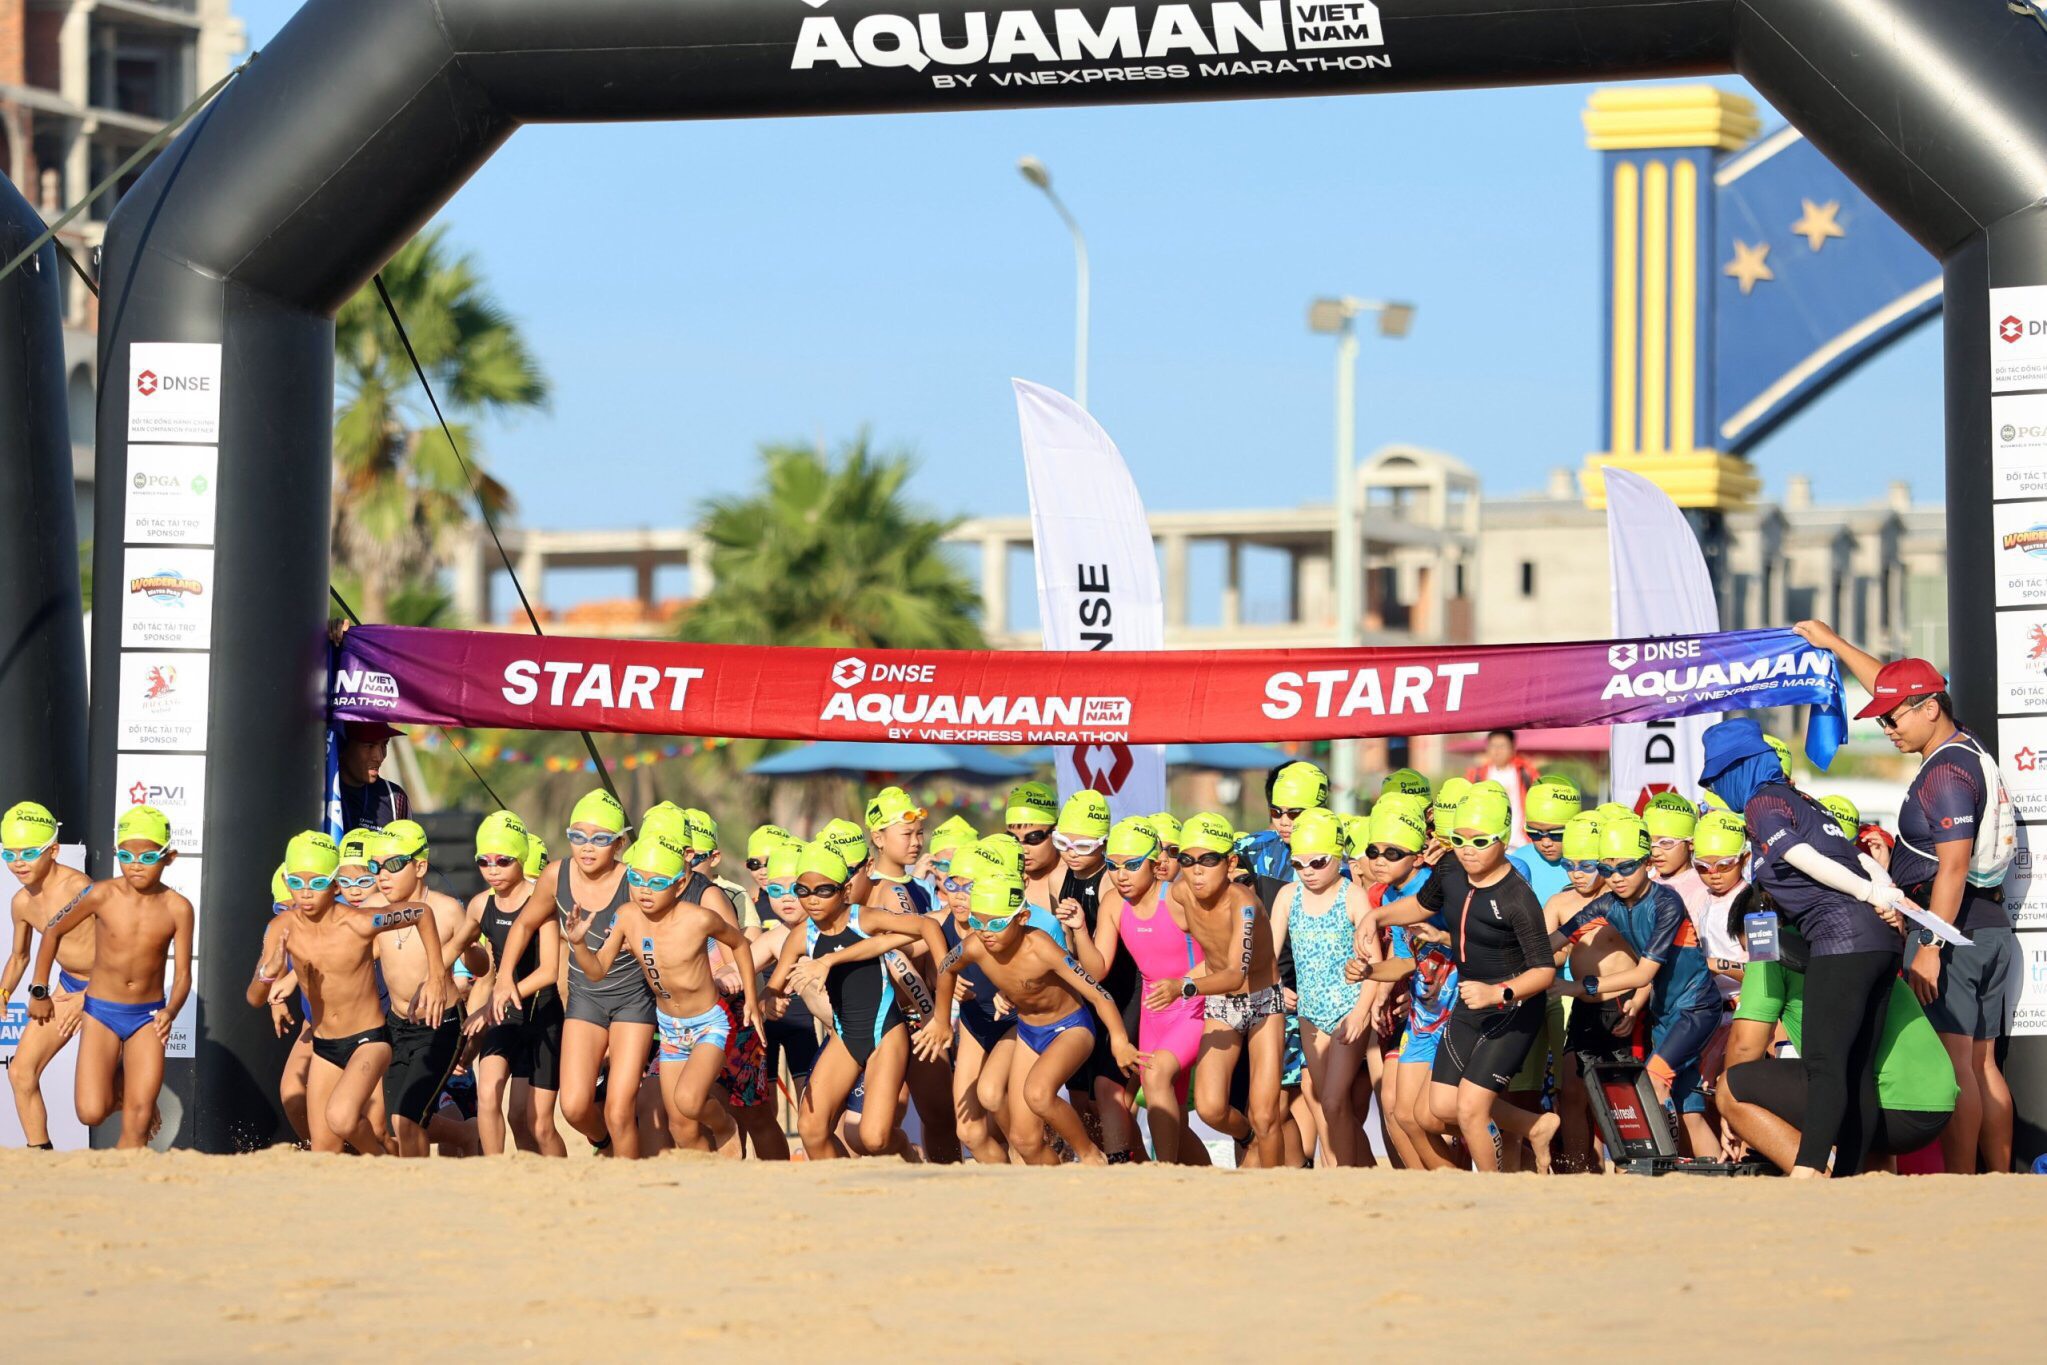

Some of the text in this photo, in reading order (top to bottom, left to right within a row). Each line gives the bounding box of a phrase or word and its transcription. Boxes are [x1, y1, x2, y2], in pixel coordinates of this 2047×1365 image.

[1296, 3, 1364, 22] VIET
[791, 0, 1288, 72] AQUAMAN
[1298, 24, 1369, 42] NAM
[932, 53, 1392, 88] BY VNEXPRESS MARATHON
[163, 376, 210, 391] DNSE
[148, 475, 180, 487] PGA
[147, 529, 186, 537] SPONSOR
[144, 633, 182, 641] SPONSOR
[1644, 639, 1701, 662] DNSE
[368, 675, 392, 686] VIET
[871, 664, 936, 683] DNSE
[1600, 651, 1832, 700] AQUAMAN
[365, 684, 394, 694] NAM
[502, 660, 704, 711] START
[1261, 662, 1479, 720] START
[1665, 677, 1838, 704] BY VNEXPRESS MARAT
[820, 693, 1083, 726] AQUAMAN
[1089, 701, 1125, 711] VIET
[1085, 711, 1124, 721] NAM
[140, 736, 178, 744] SPONSOR
[888, 728, 1129, 743] BY VNEXPRESS MARATHON
[149, 786, 184, 799] PVI
[1953, 815, 1973, 825] DNSE
[1767, 828, 1787, 846] DNSE
